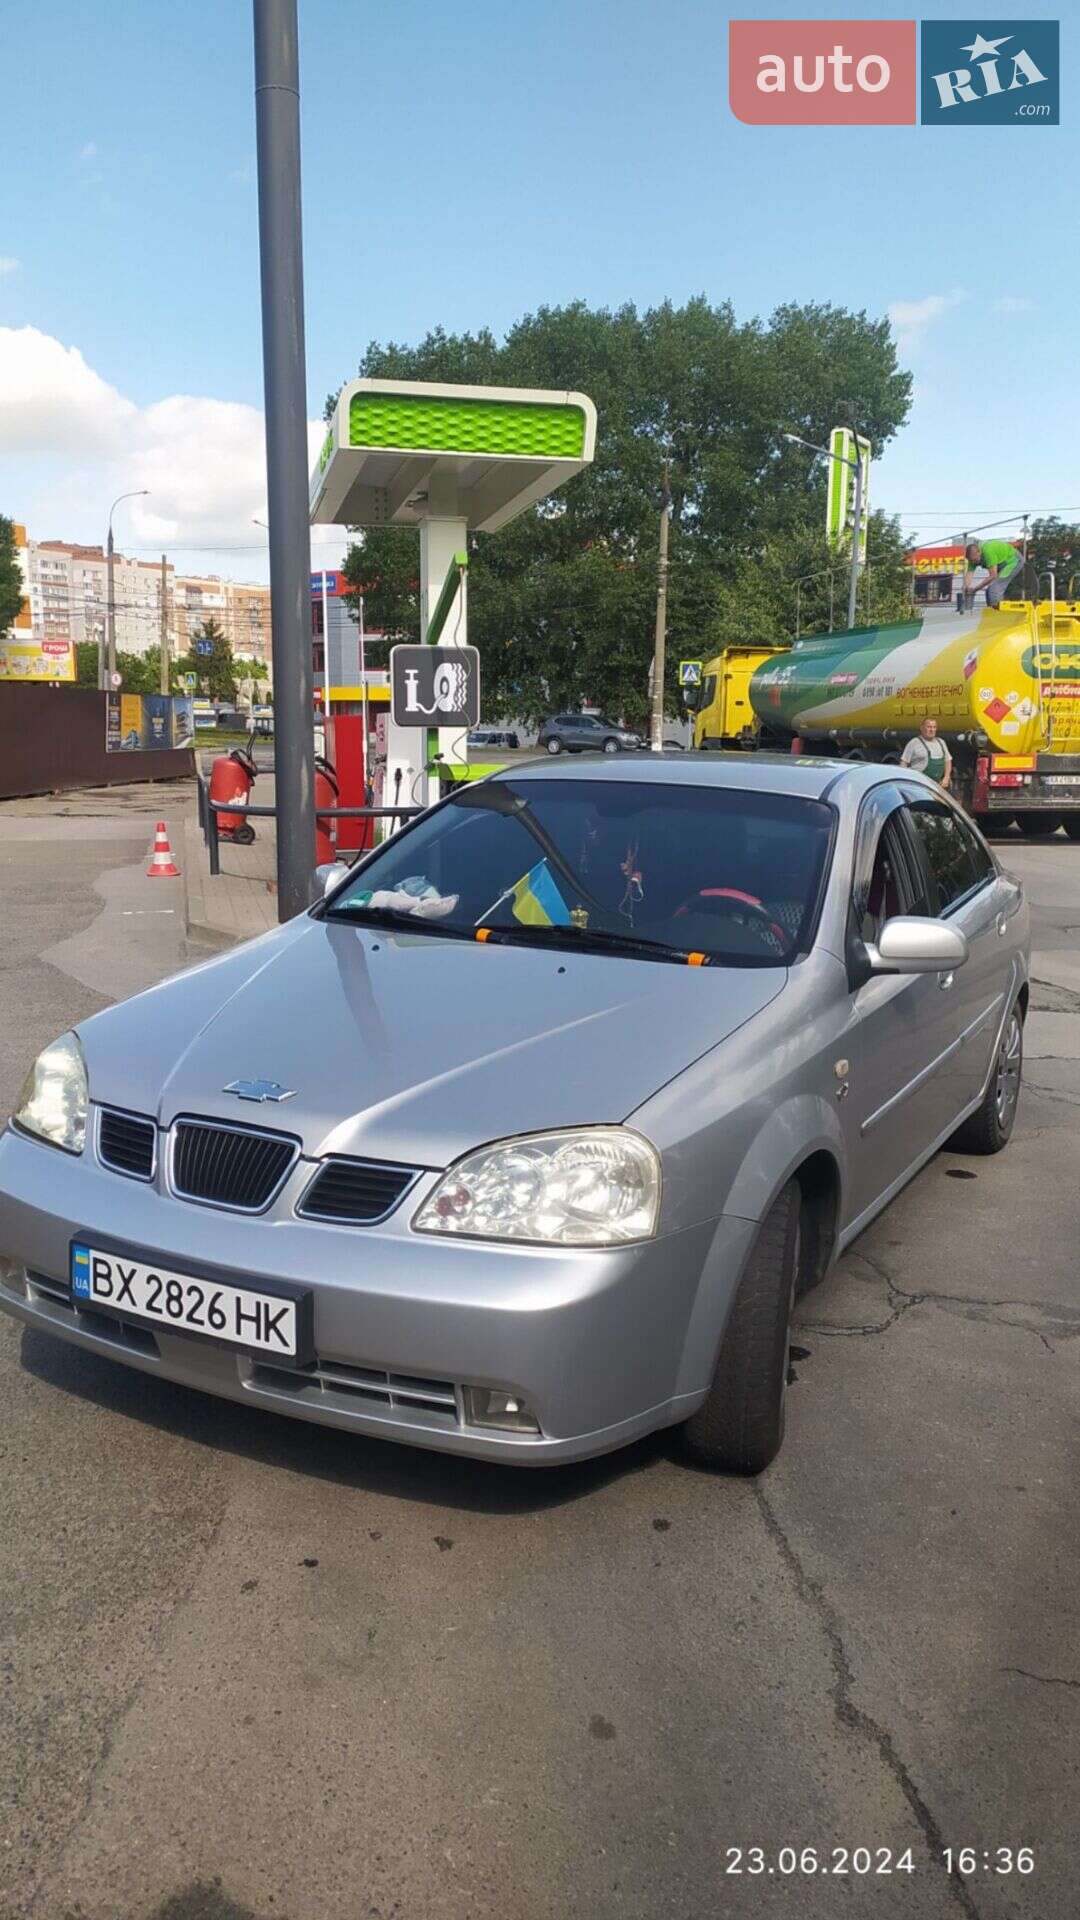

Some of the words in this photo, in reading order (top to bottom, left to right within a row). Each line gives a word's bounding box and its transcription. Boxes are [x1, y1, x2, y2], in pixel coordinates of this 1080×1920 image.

[75, 1277, 89, 1291] UA
[92, 1256, 137, 1307] BX
[145, 1273, 227, 1330] 2826
[235, 1296, 290, 1348] HK
